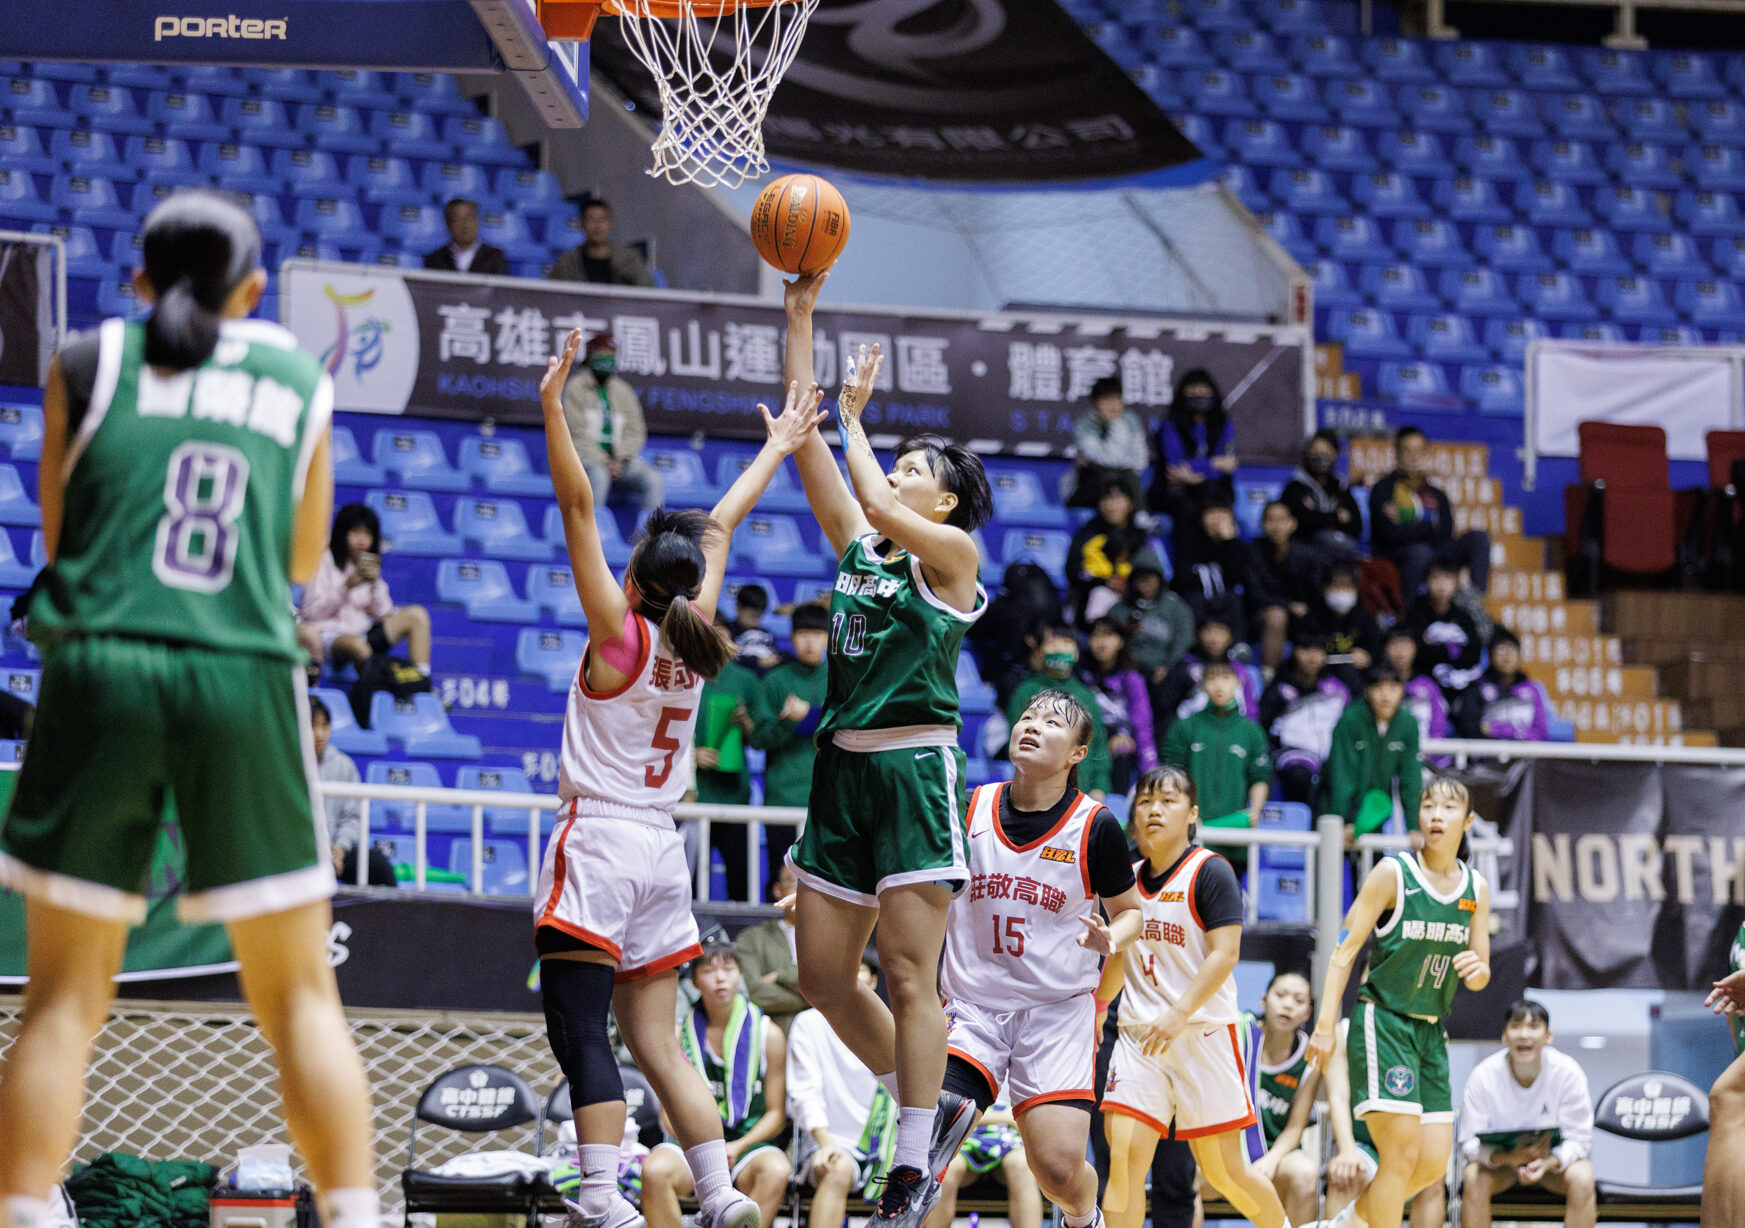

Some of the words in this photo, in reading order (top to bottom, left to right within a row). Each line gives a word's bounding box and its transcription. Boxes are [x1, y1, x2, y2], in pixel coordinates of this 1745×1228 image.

[783, 186, 807, 248] ALDING
[828, 212, 840, 237] FIBA
[437, 373, 542, 404] KAOHSIU
[152, 439, 249, 595] 8
[835, 571, 904, 598] 明高中
[832, 612, 866, 656] 10
[649, 655, 701, 690] 張可
[644, 706, 693, 789] 5
[970, 873, 1067, 914] 莊敬高職
[992, 915, 1026, 958] 15
[1137, 918, 1186, 948] 高職
[1140, 954, 1158, 987] 4
[1417, 954, 1451, 989] 14
